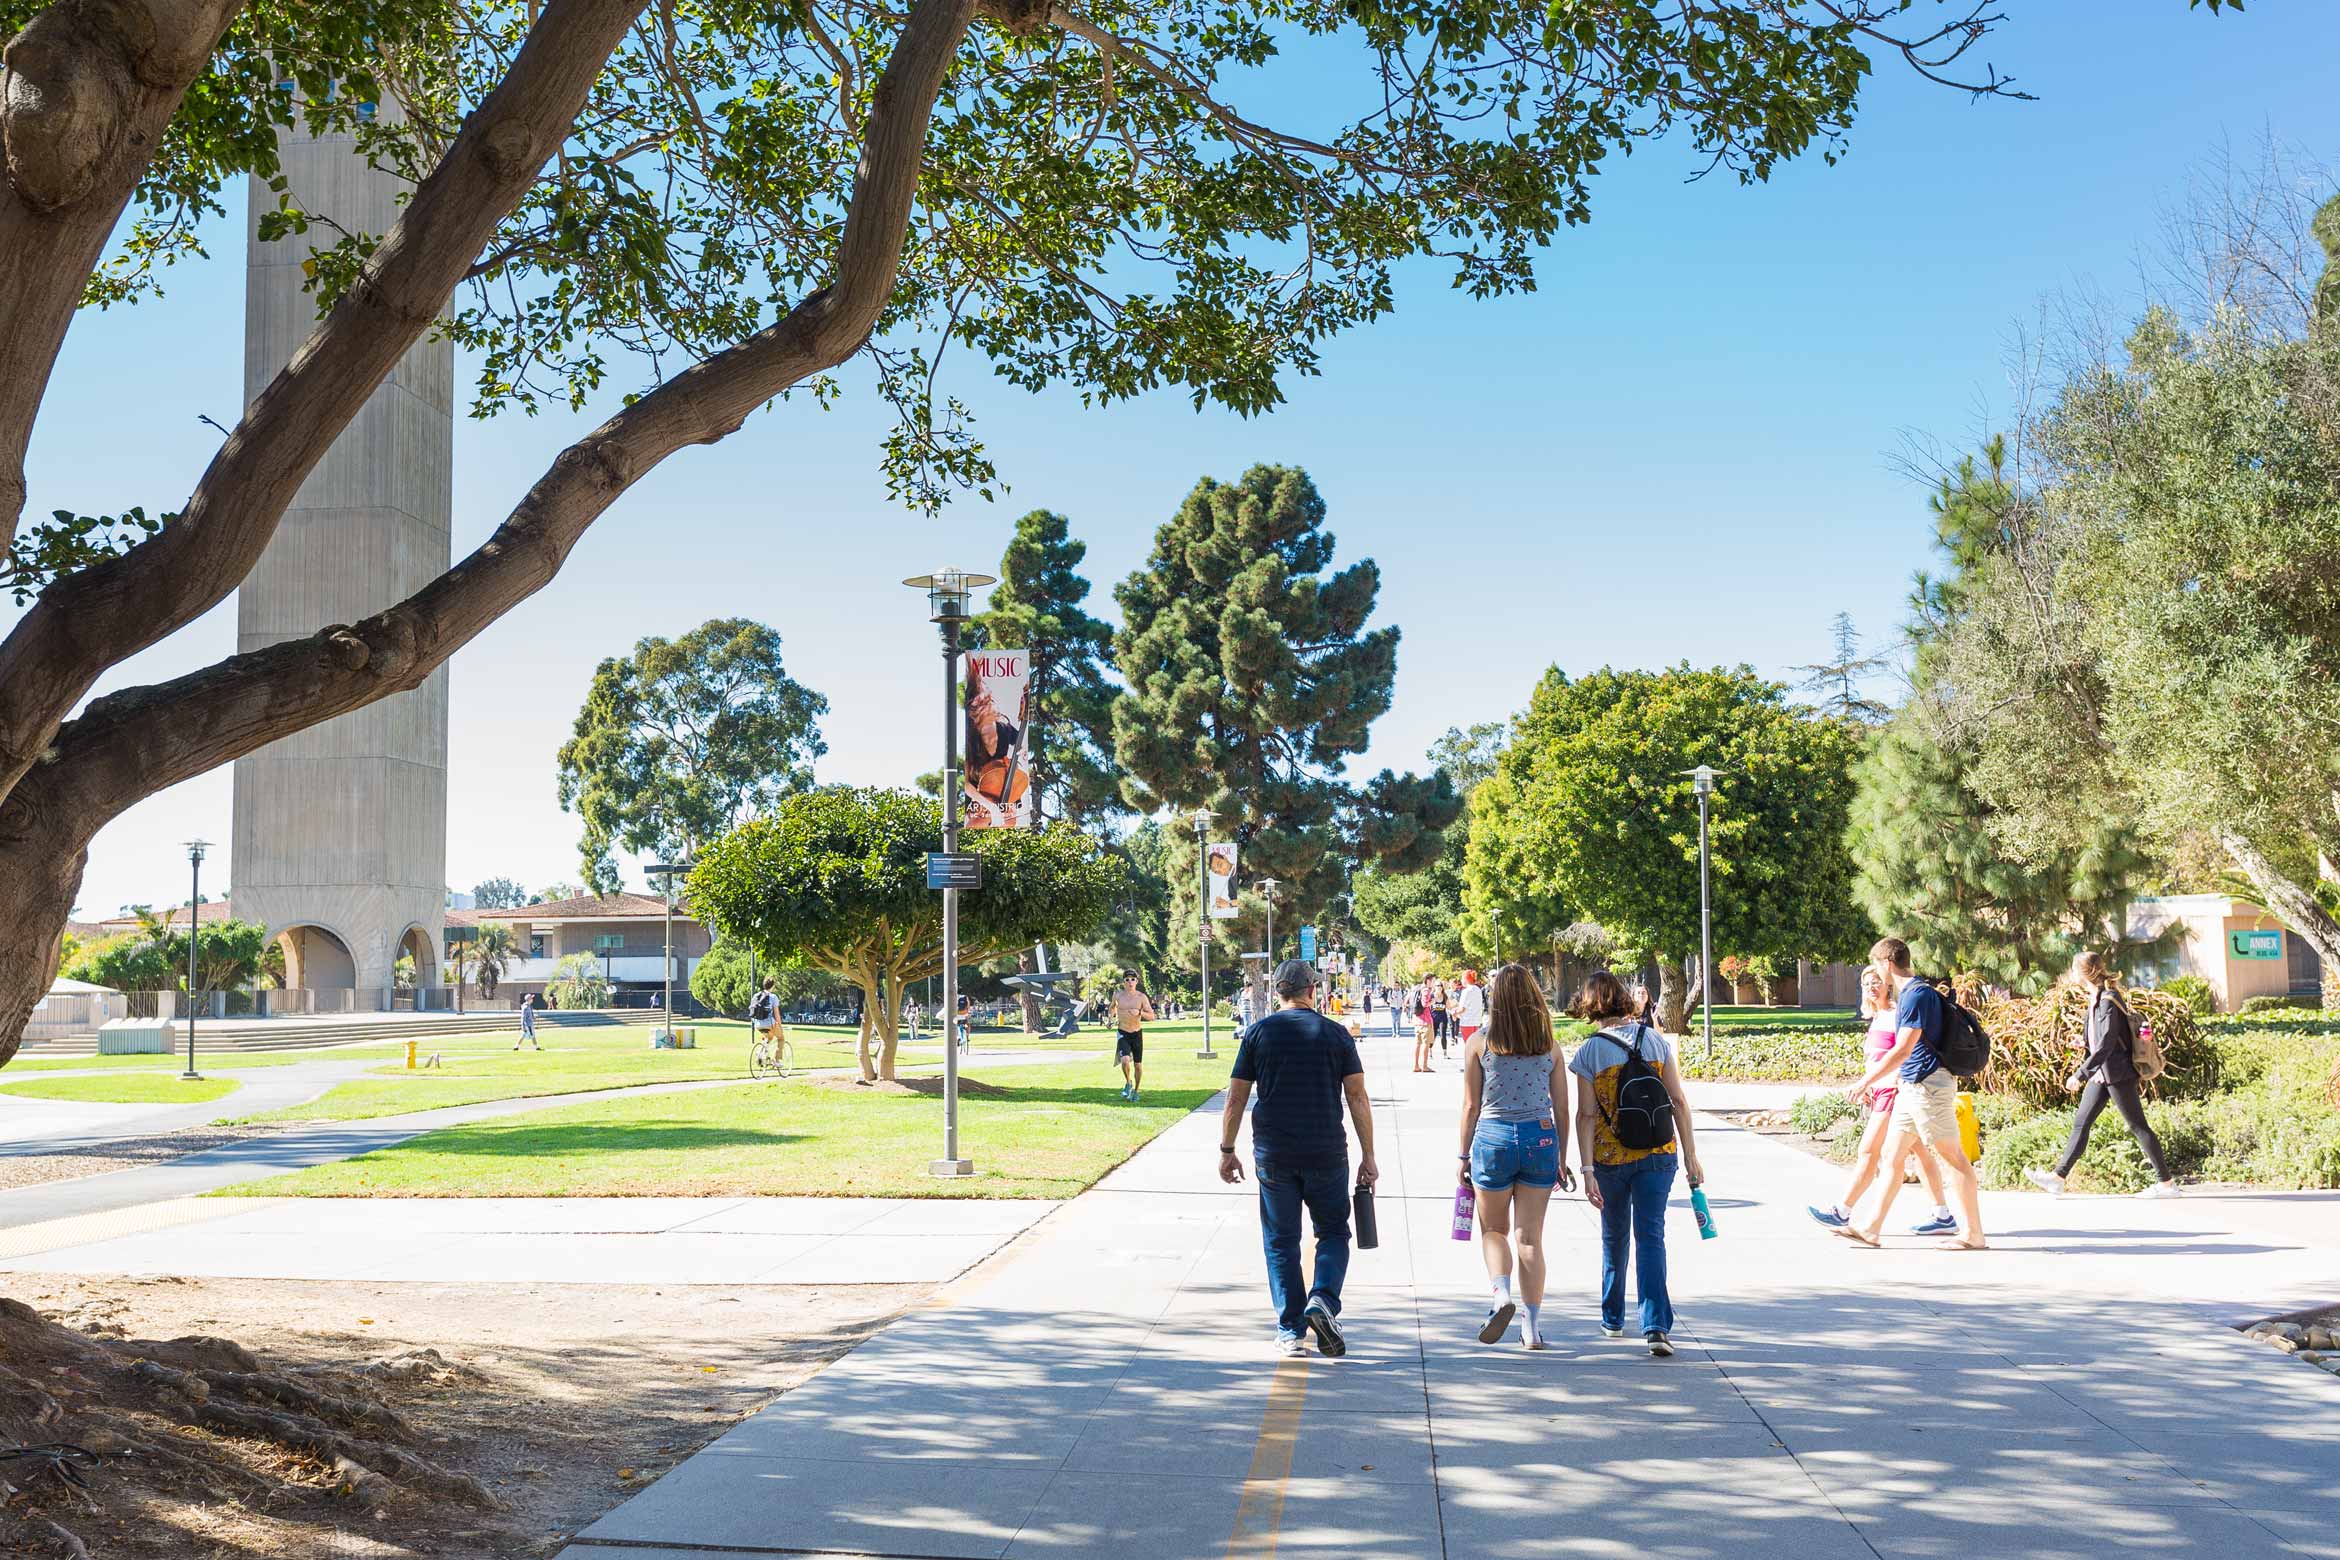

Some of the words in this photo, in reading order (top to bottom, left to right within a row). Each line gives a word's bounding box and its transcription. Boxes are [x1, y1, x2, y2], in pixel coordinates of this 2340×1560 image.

[972, 657, 1022, 678] MUSIC
[1211, 847, 1233, 855] MUSIC
[2249, 936, 2278, 950] ANNEX
